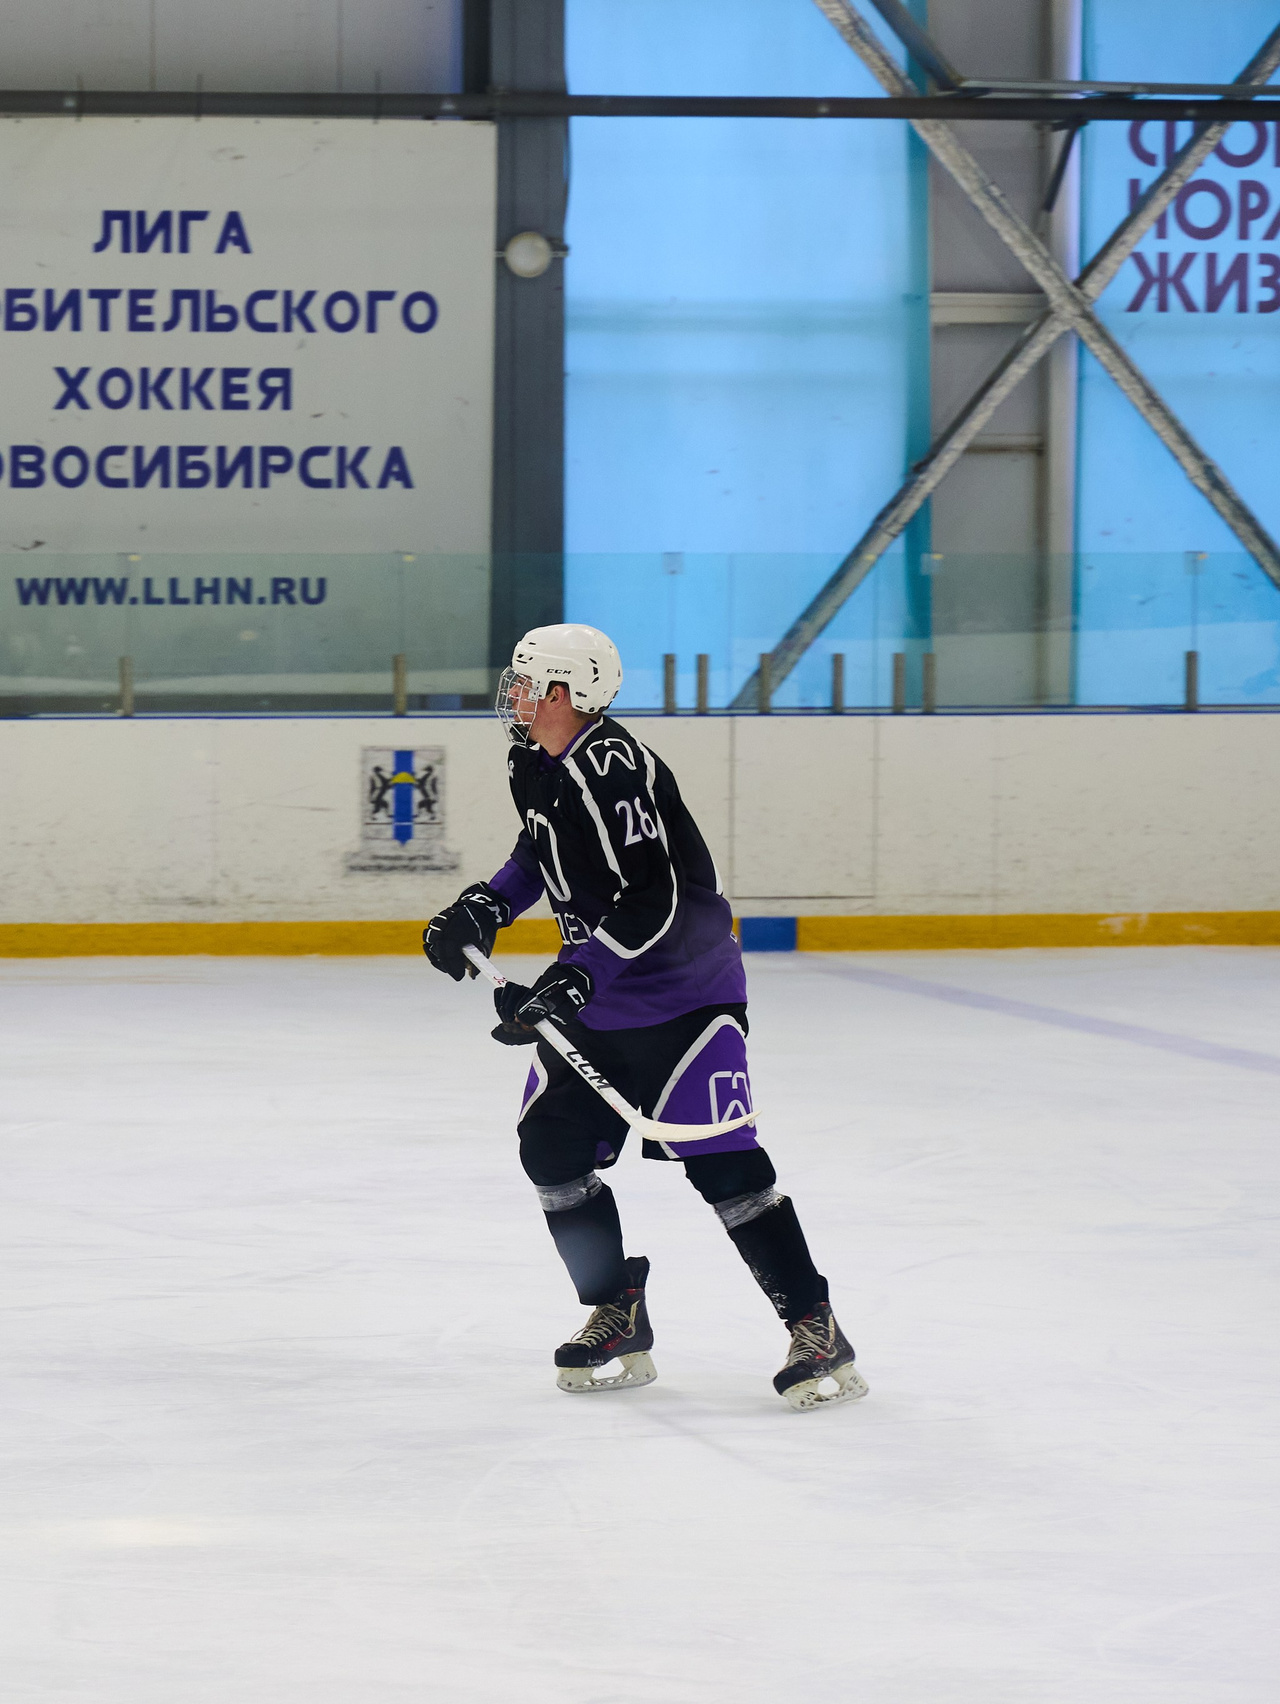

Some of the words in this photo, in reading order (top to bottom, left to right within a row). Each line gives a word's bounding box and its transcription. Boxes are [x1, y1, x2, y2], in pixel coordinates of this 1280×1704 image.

[1128, 120, 1280, 168] СО
[92, 209, 253, 255] ЛИГА
[1129, 178, 1280, 241] ОР
[53, 366, 293, 412] ХОККЕЯ
[16, 577, 327, 607] WWW.LLHN.RU
[566, 1051, 613, 1090] CCM
